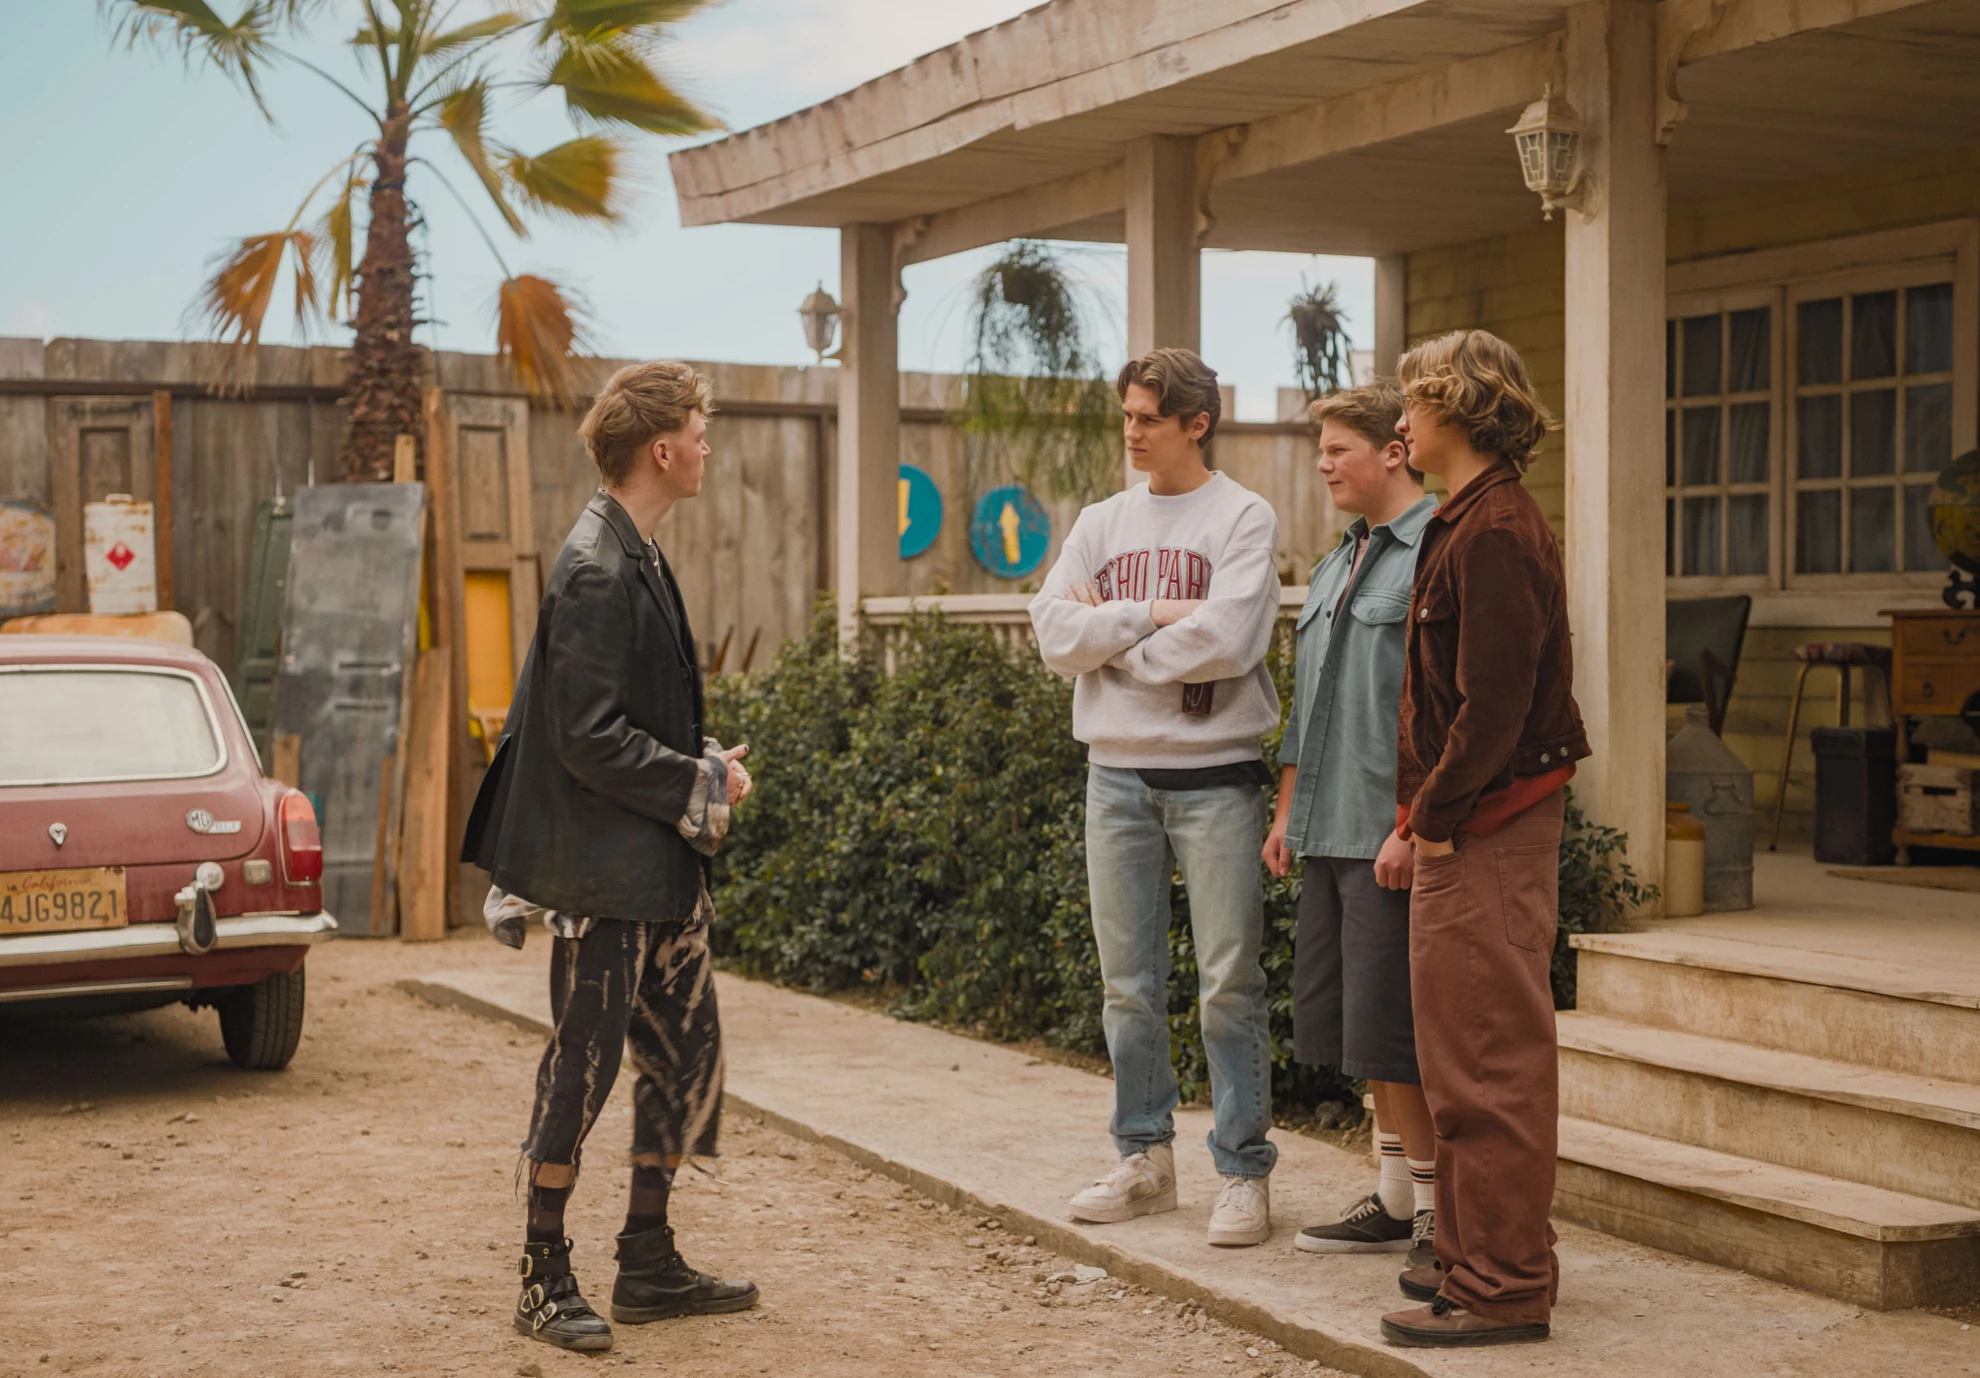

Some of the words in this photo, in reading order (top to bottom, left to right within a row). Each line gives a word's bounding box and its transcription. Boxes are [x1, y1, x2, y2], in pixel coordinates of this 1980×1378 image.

[1094, 548, 1150, 603] EHO
[190, 812, 211, 829] MG
[22, 874, 98, 892] California
[1, 889, 118, 924] 4JG9821
